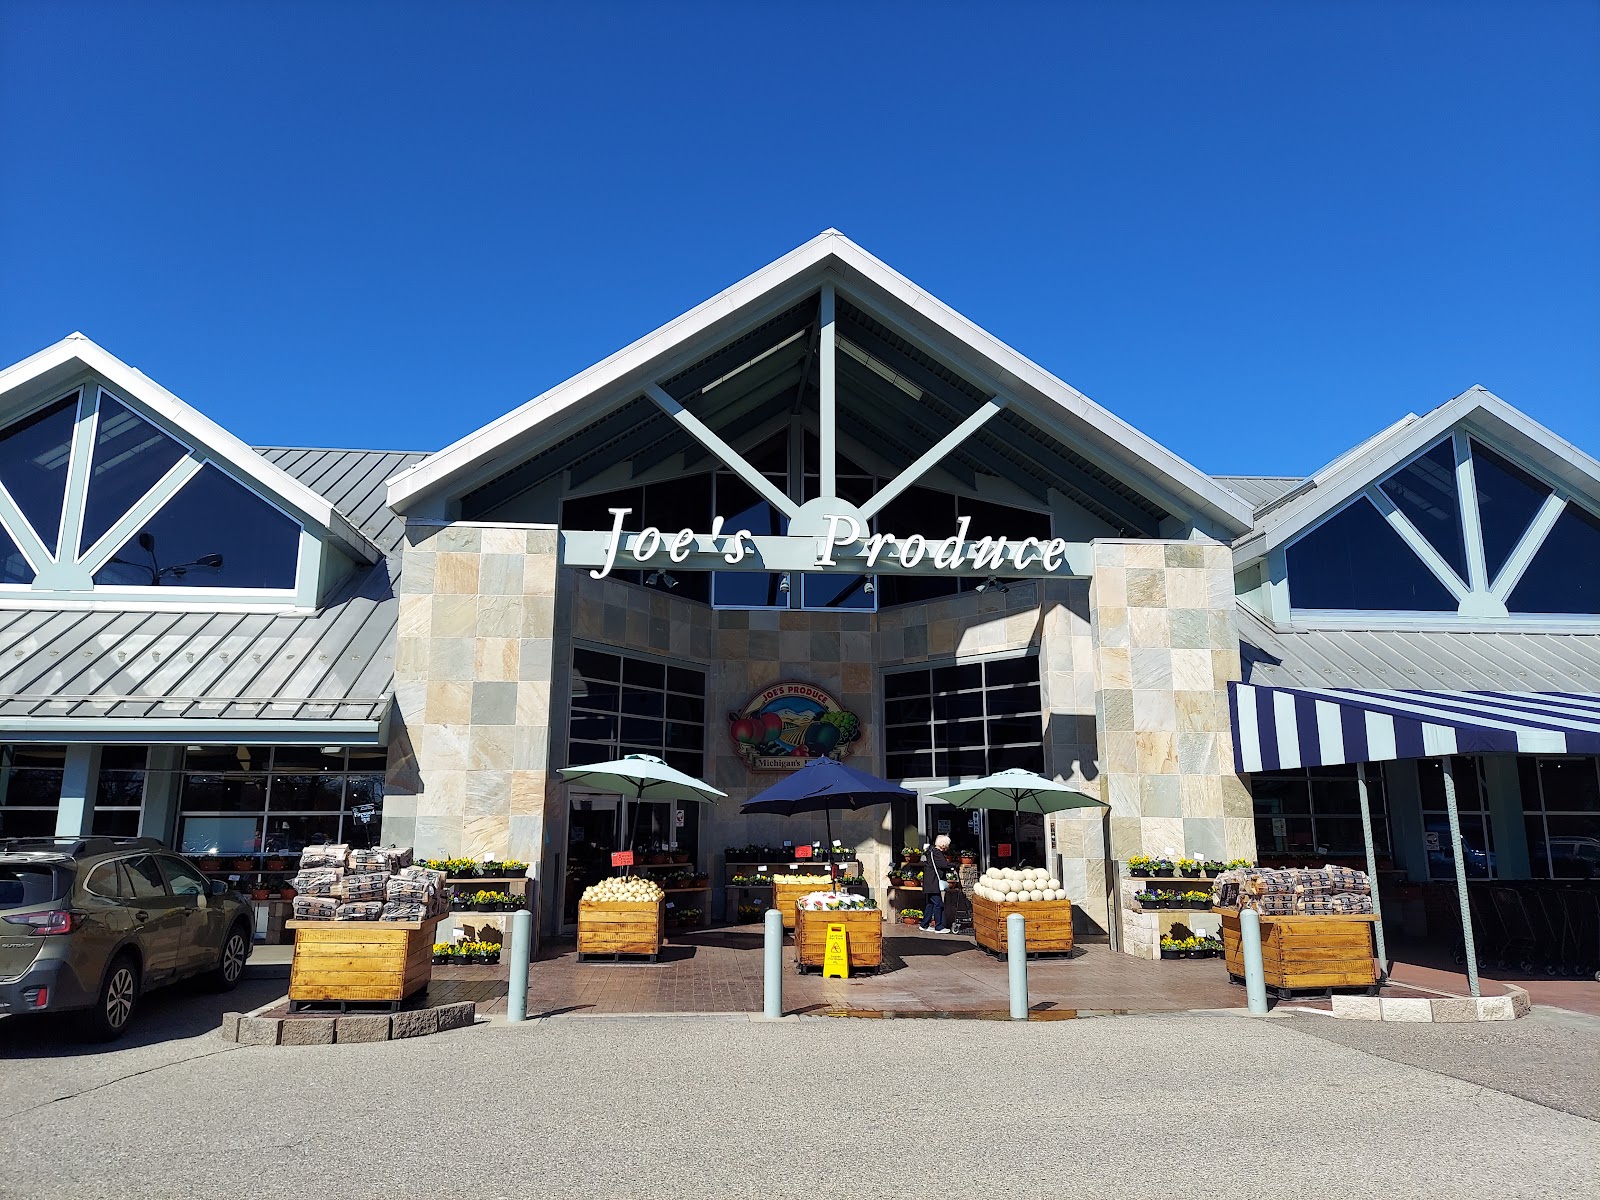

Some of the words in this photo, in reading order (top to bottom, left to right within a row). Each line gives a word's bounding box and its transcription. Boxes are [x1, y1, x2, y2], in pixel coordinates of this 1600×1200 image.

[590, 507, 753, 580] Joe's
[814, 513, 1067, 572] Produce
[763, 686, 785, 702] JOE'S
[787, 686, 829, 704] PRODUCE
[759, 758, 801, 769] Michigan's
